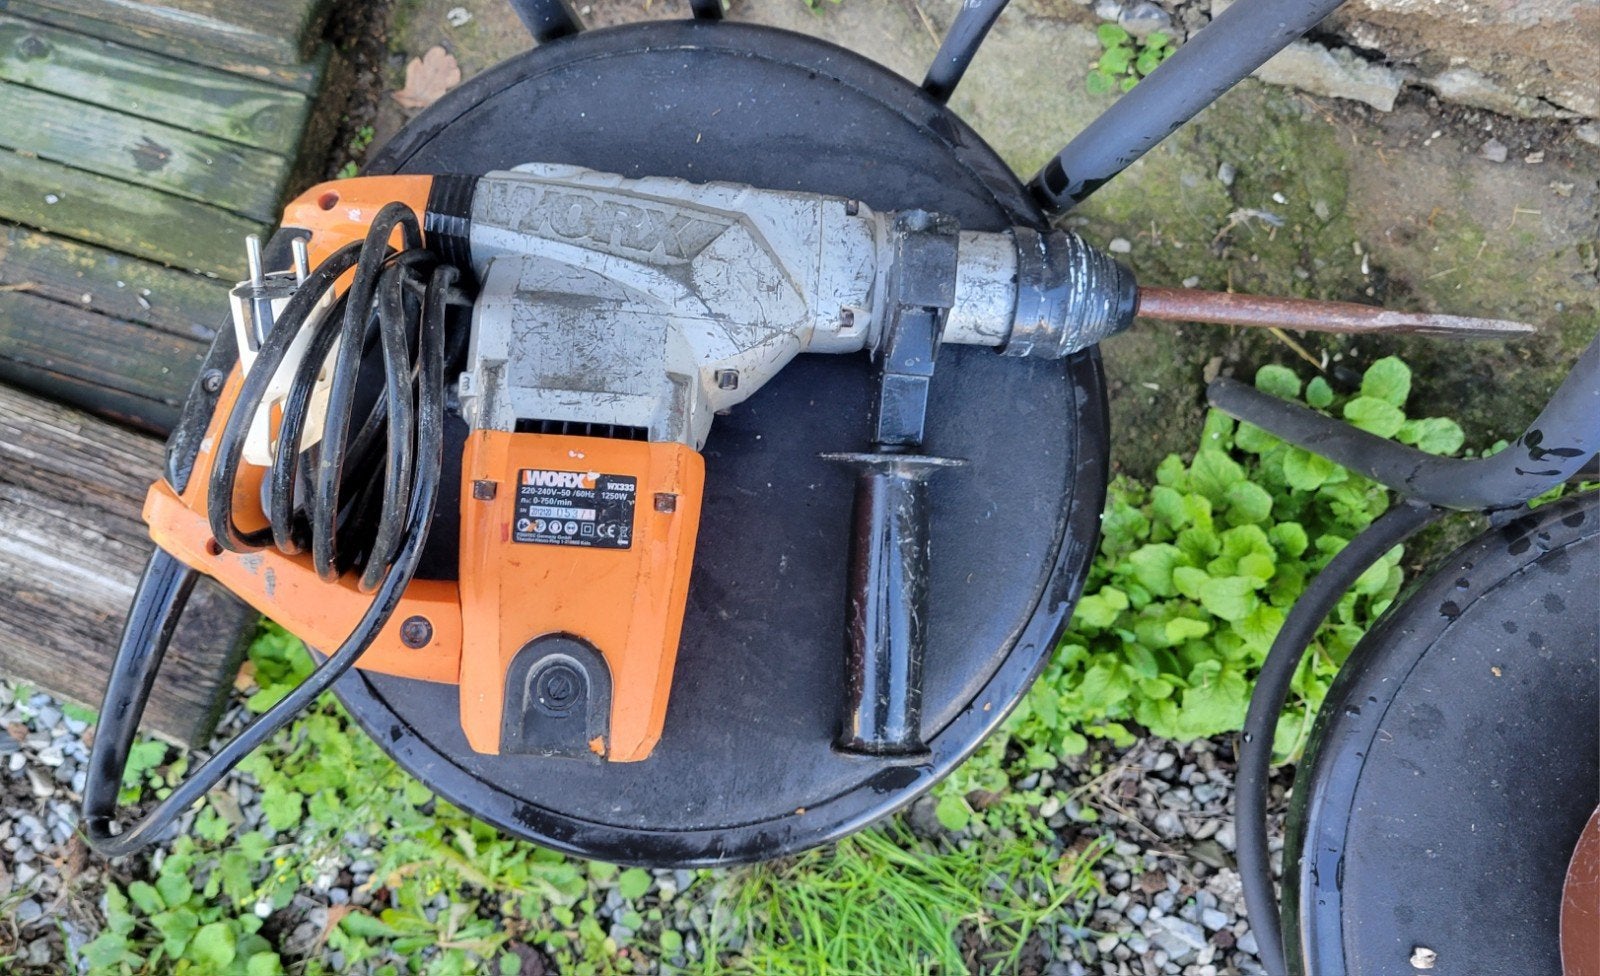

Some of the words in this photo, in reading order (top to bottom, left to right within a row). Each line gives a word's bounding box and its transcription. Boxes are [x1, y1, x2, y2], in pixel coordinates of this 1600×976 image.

[491, 182, 694, 258] WORX
[527, 470, 587, 488] WORX
[606, 482, 635, 492] WX333
[602, 492, 628, 501] 1250W
